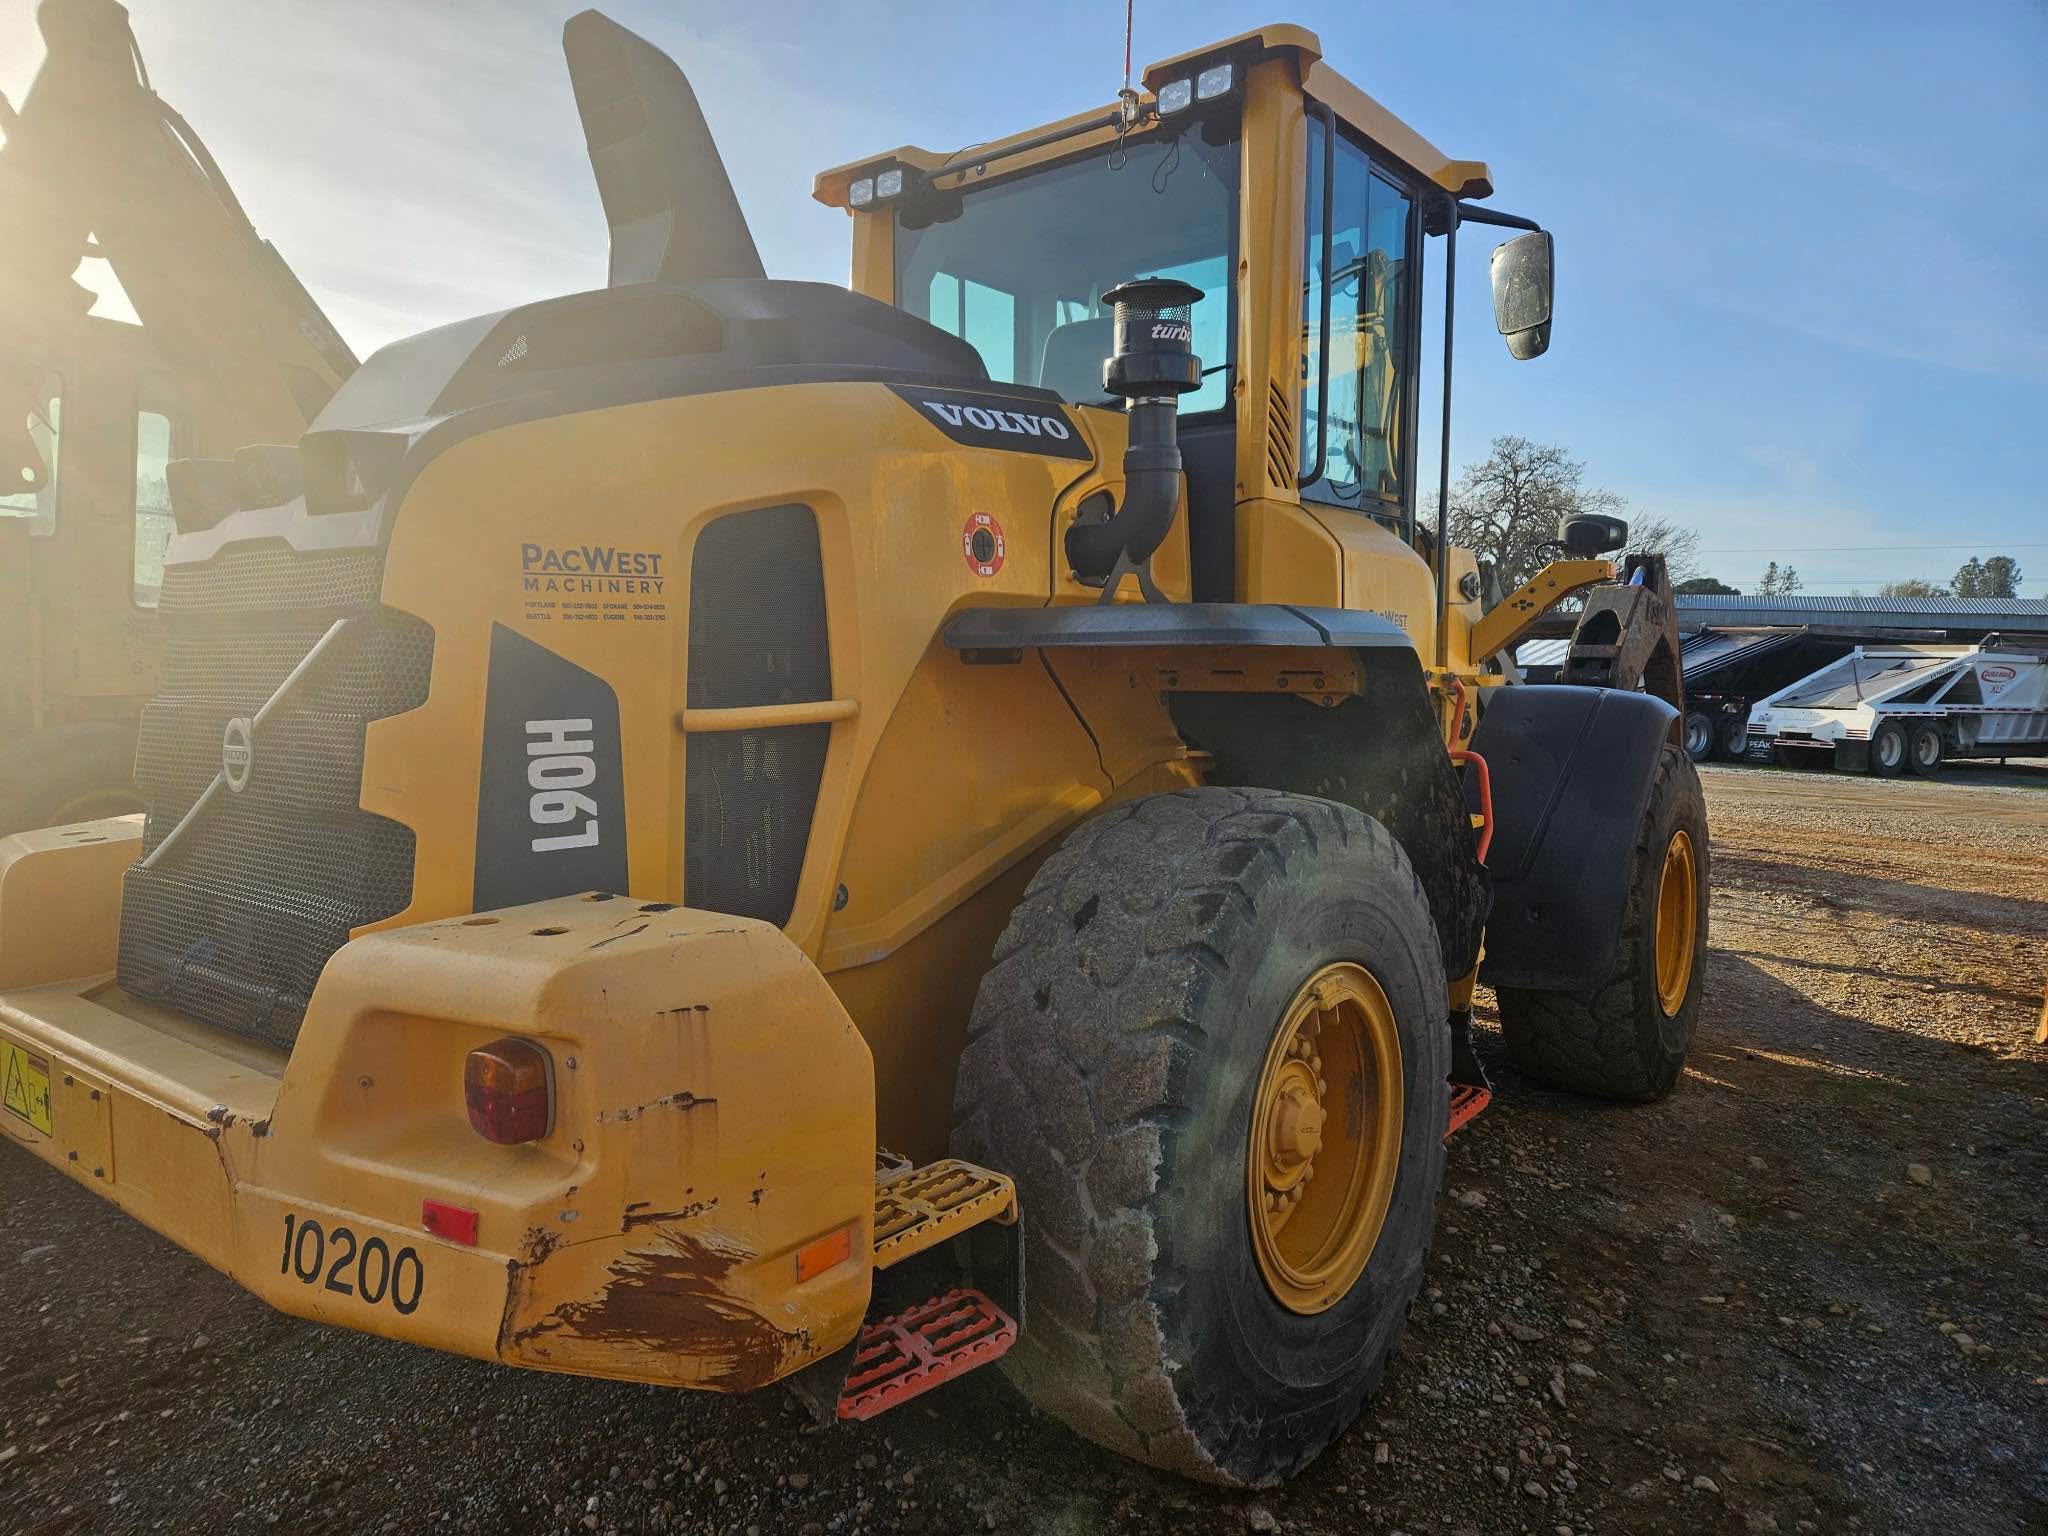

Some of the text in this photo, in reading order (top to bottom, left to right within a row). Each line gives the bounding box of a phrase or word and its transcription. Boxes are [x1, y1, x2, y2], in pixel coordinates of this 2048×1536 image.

[922, 401, 1070, 440] VOLVO
[524, 577, 664, 594] MACHINERY
[1749, 740, 1771, 749] PEAK
[525, 718, 600, 853] L90H
[281, 1213, 424, 1316] 10200
